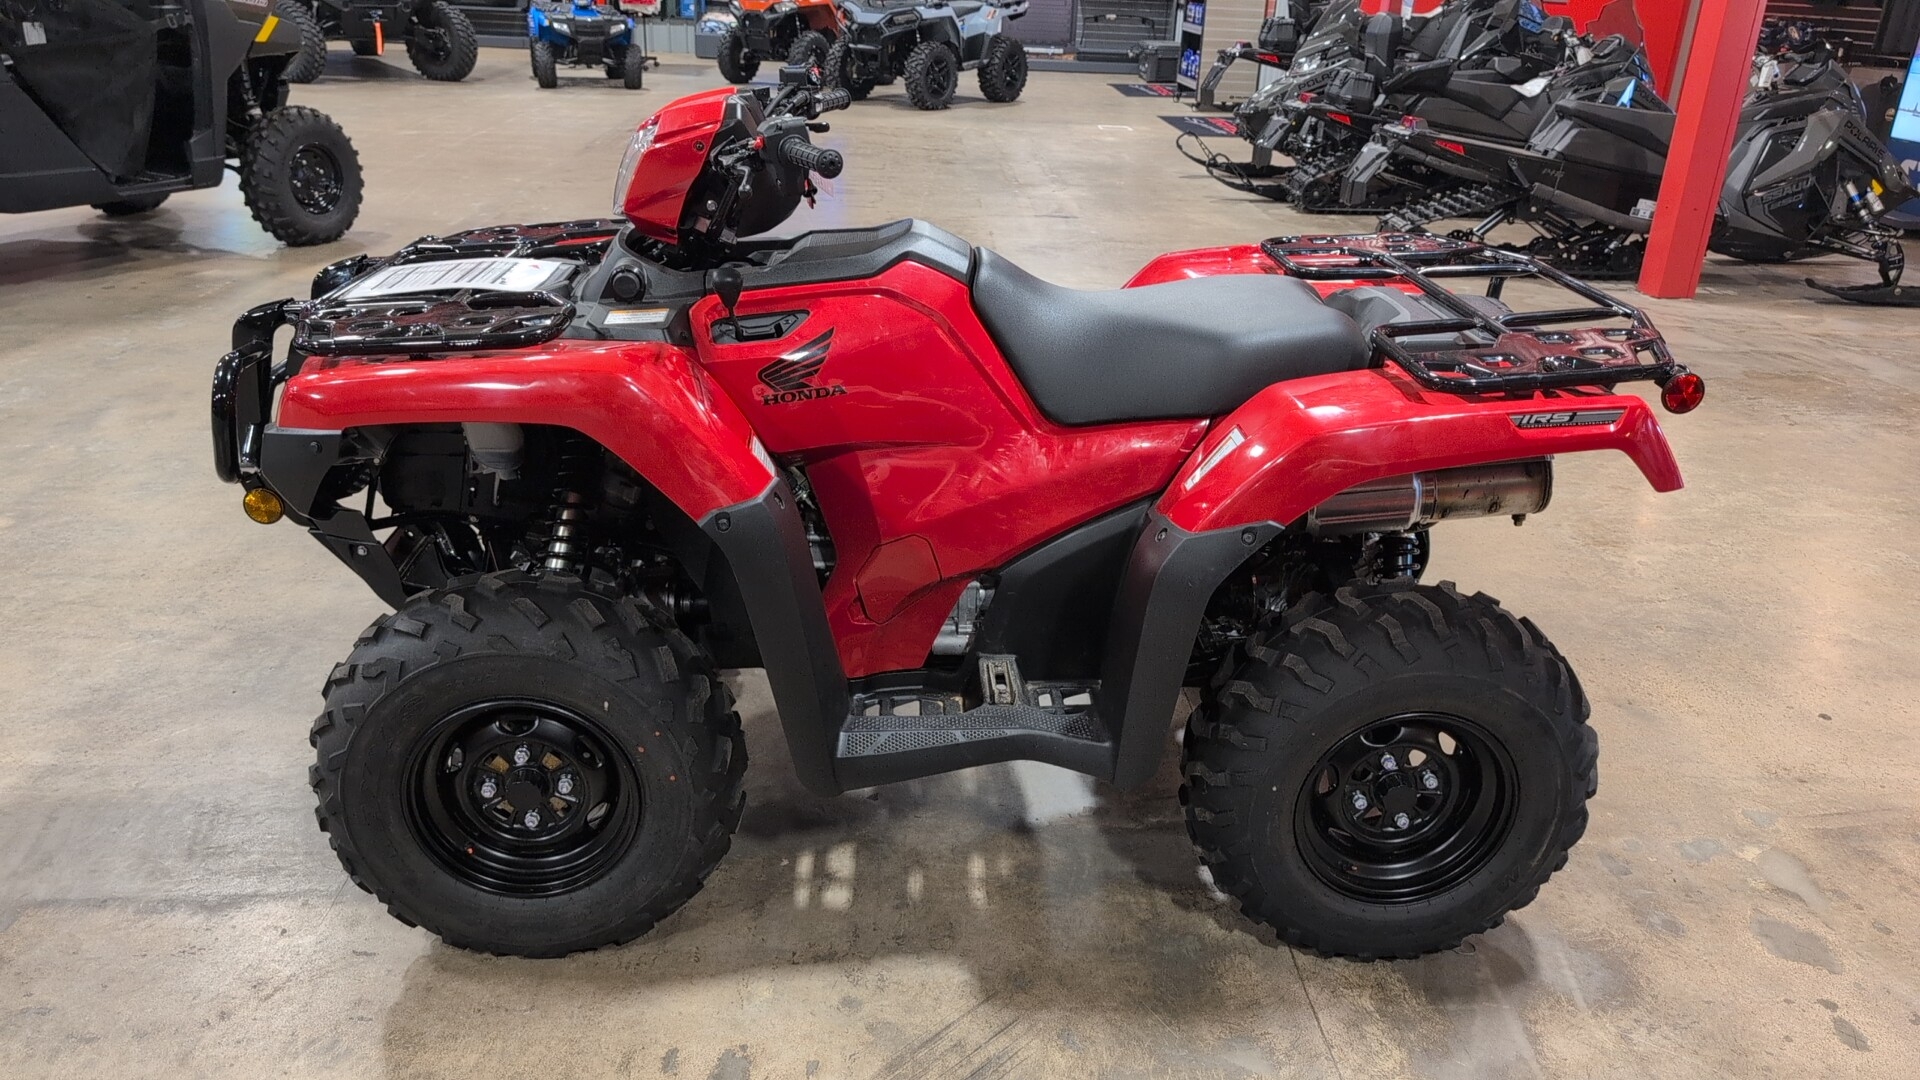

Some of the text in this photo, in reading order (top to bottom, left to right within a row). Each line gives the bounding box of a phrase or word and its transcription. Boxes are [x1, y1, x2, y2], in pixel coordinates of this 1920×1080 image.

[1843, 119, 1886, 158] POLARIS
[761, 384, 848, 406] HONDA
[1520, 411, 1575, 424] IRS
